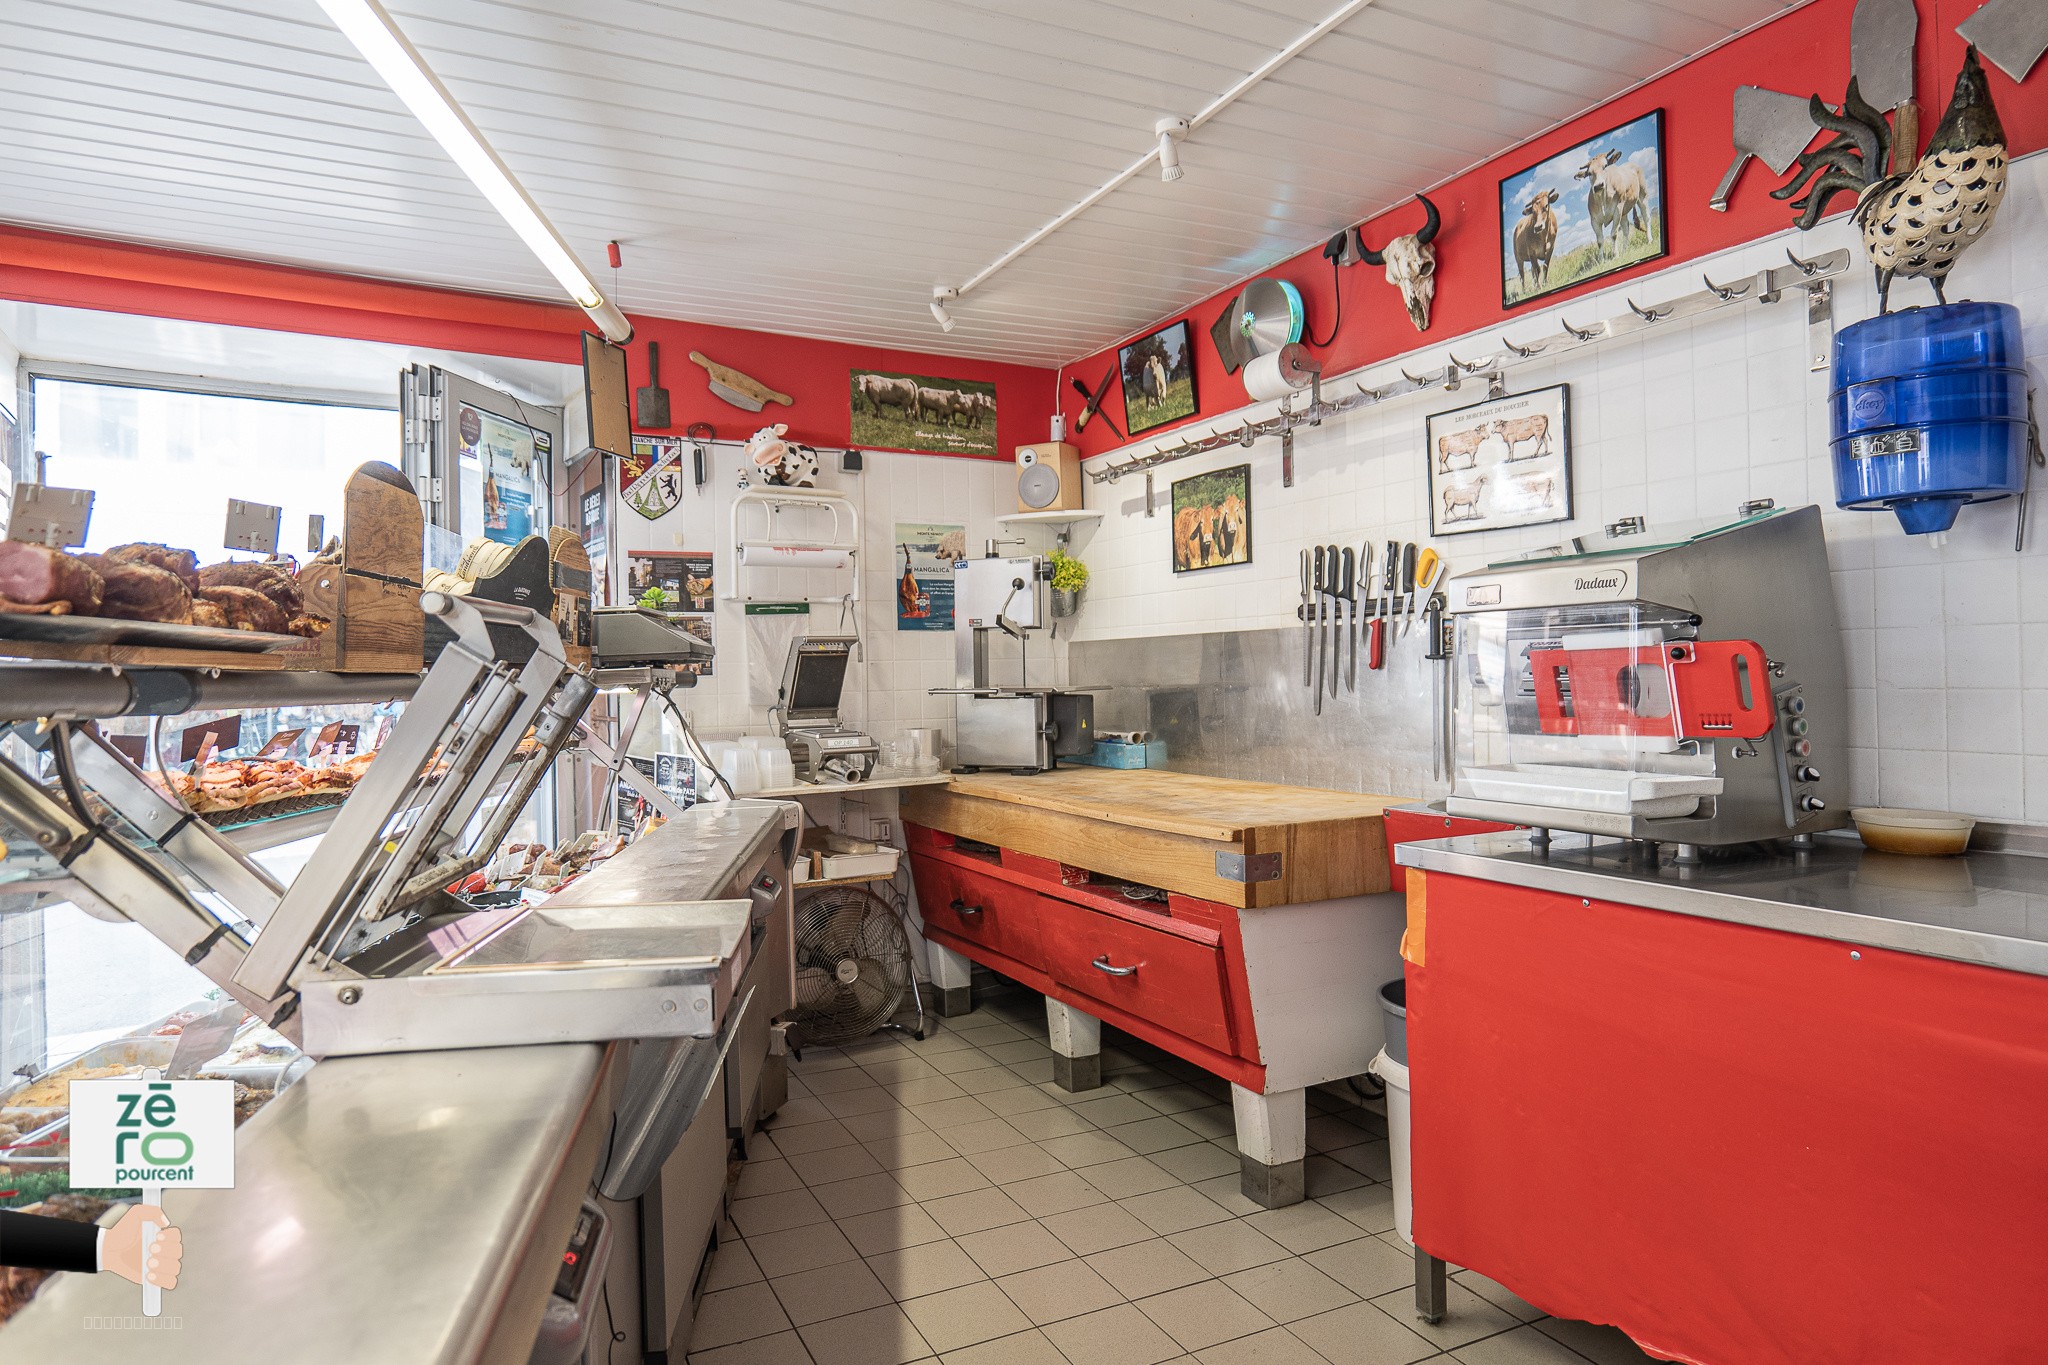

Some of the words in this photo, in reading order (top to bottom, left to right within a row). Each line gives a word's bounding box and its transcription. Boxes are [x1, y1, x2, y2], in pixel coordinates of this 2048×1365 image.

[1465, 408, 1494, 420] MORCEAUX
[1504, 400, 1530, 412] BOUCHER
[1574, 577, 1618, 591] Dadaux
[683, 788, 695, 796] PAYS
